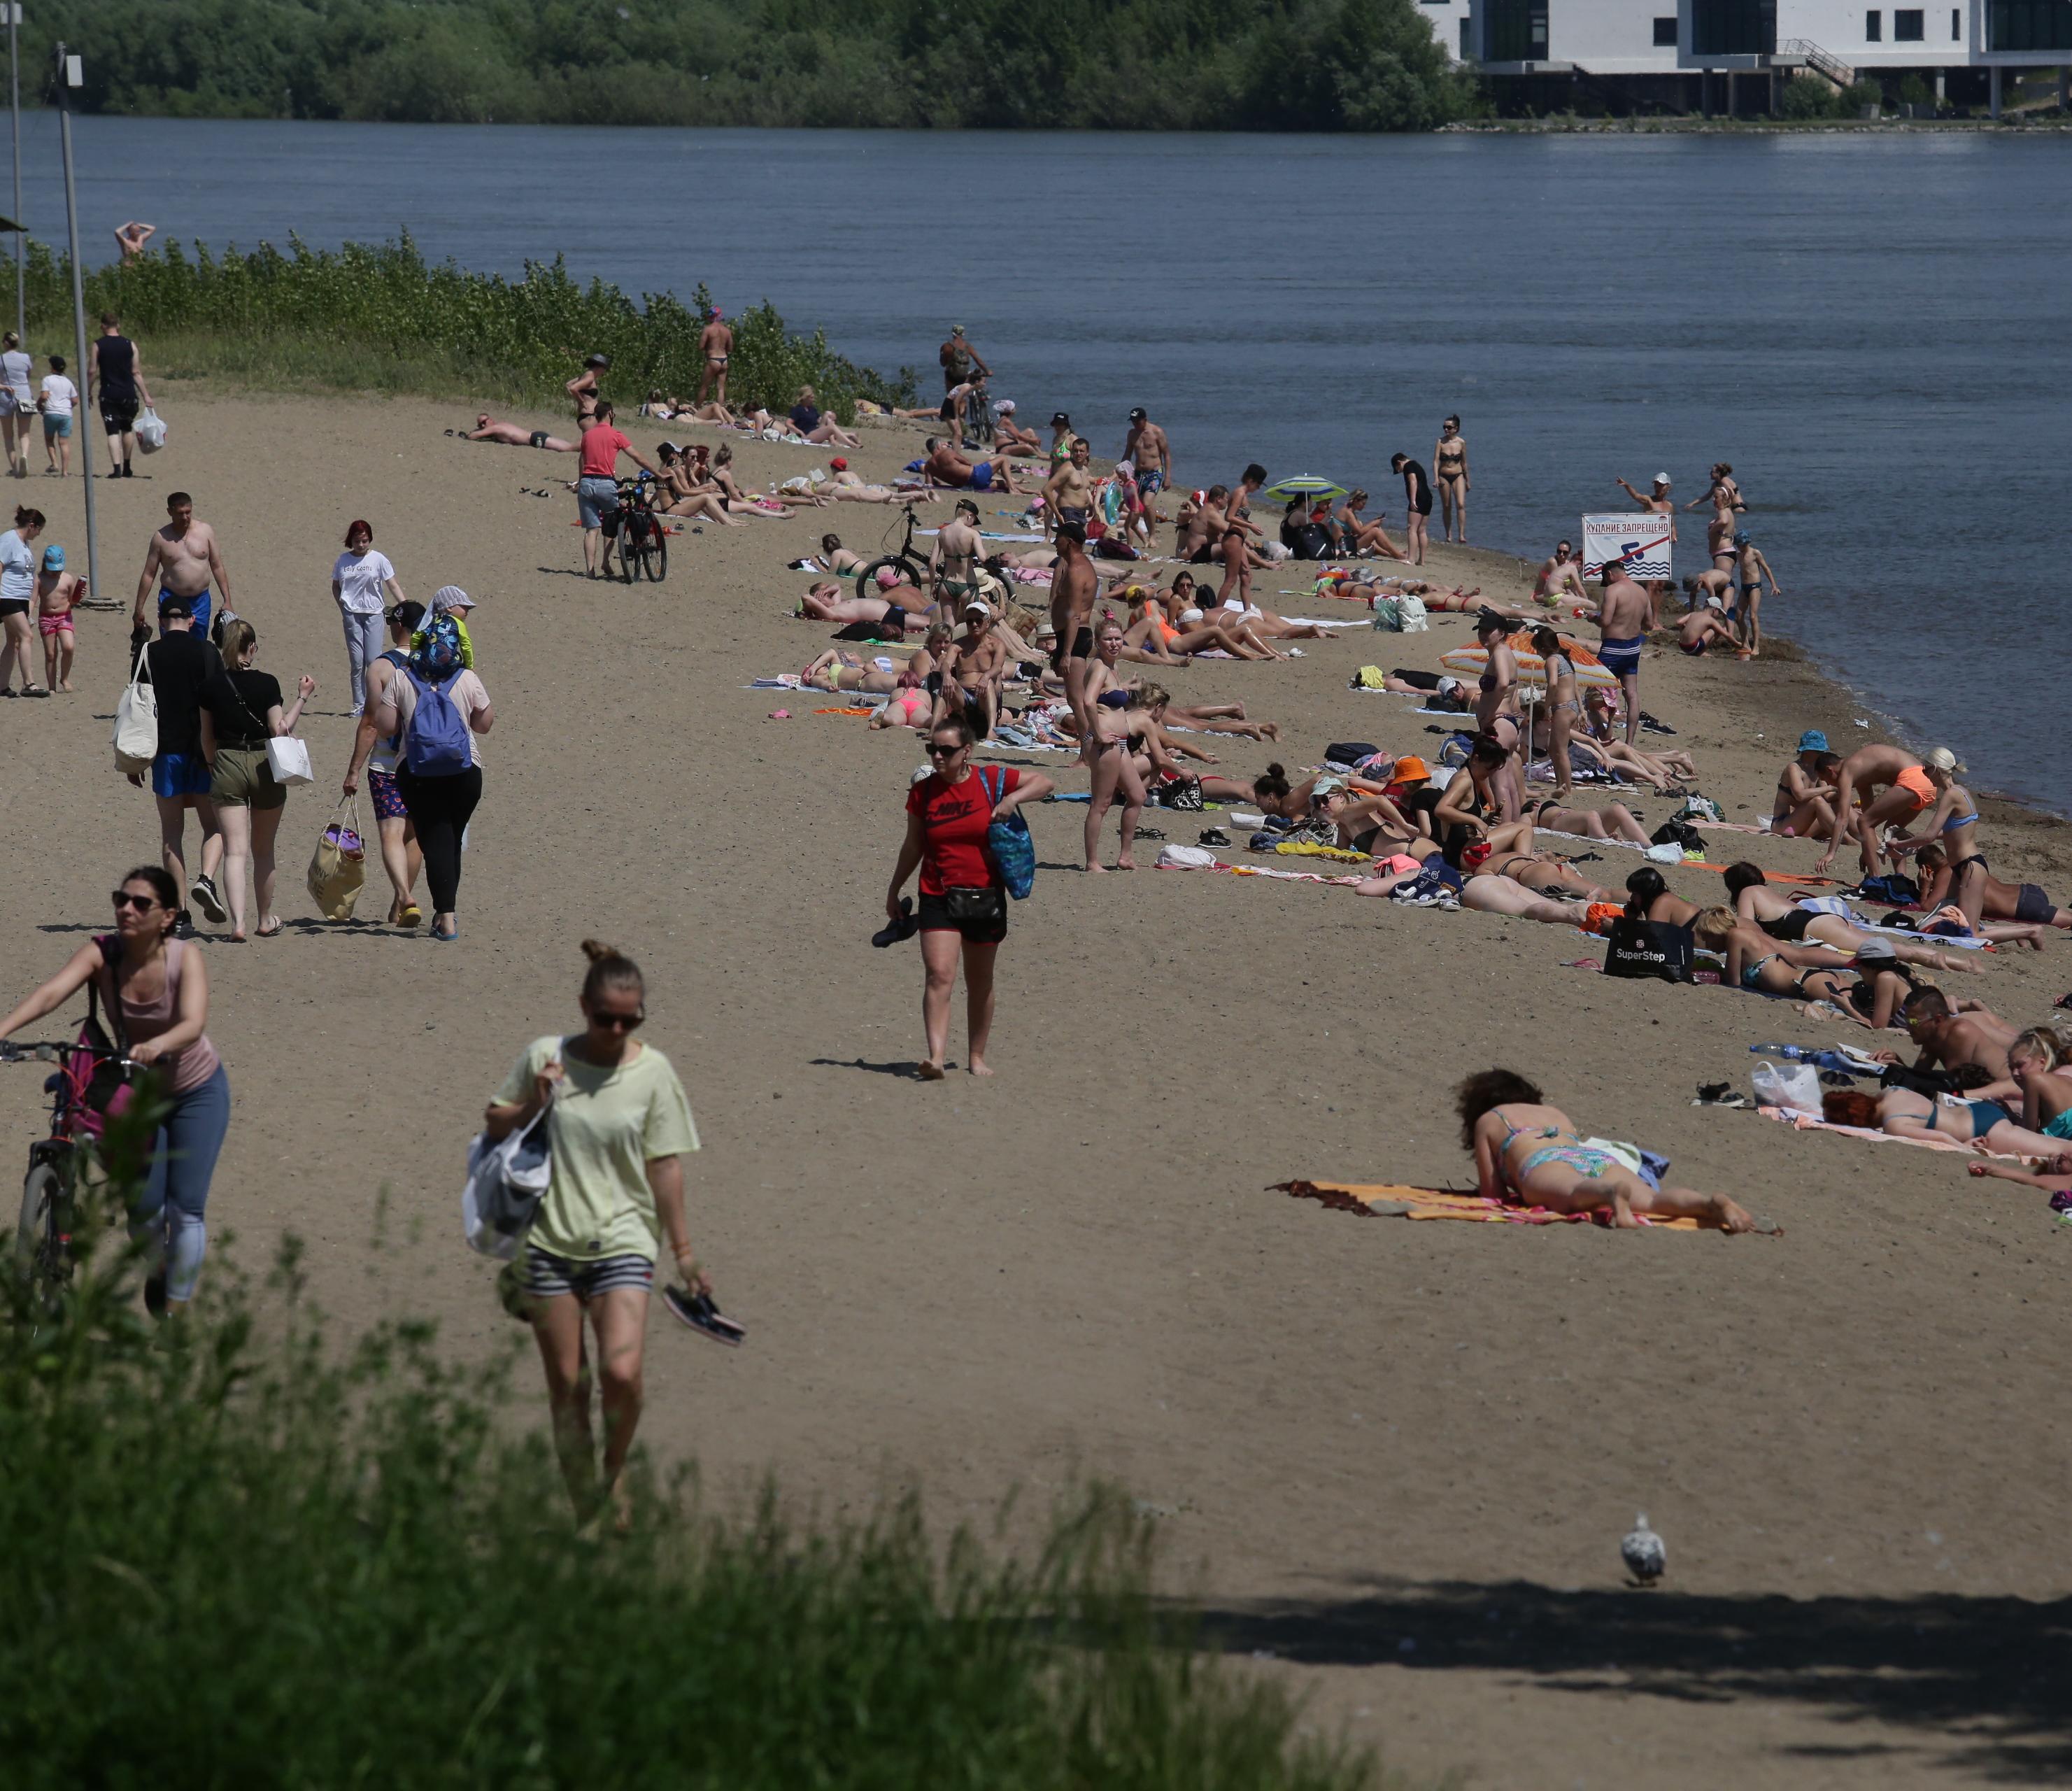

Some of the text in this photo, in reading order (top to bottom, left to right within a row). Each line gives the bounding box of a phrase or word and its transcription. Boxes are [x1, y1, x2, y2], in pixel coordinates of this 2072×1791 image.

[1587, 523, 1668, 533] КУПАНИЕ ЗАПРЕЩЕНО
[937, 800, 973, 816] NIKE
[1617, 948, 1665, 963] SuperStep
